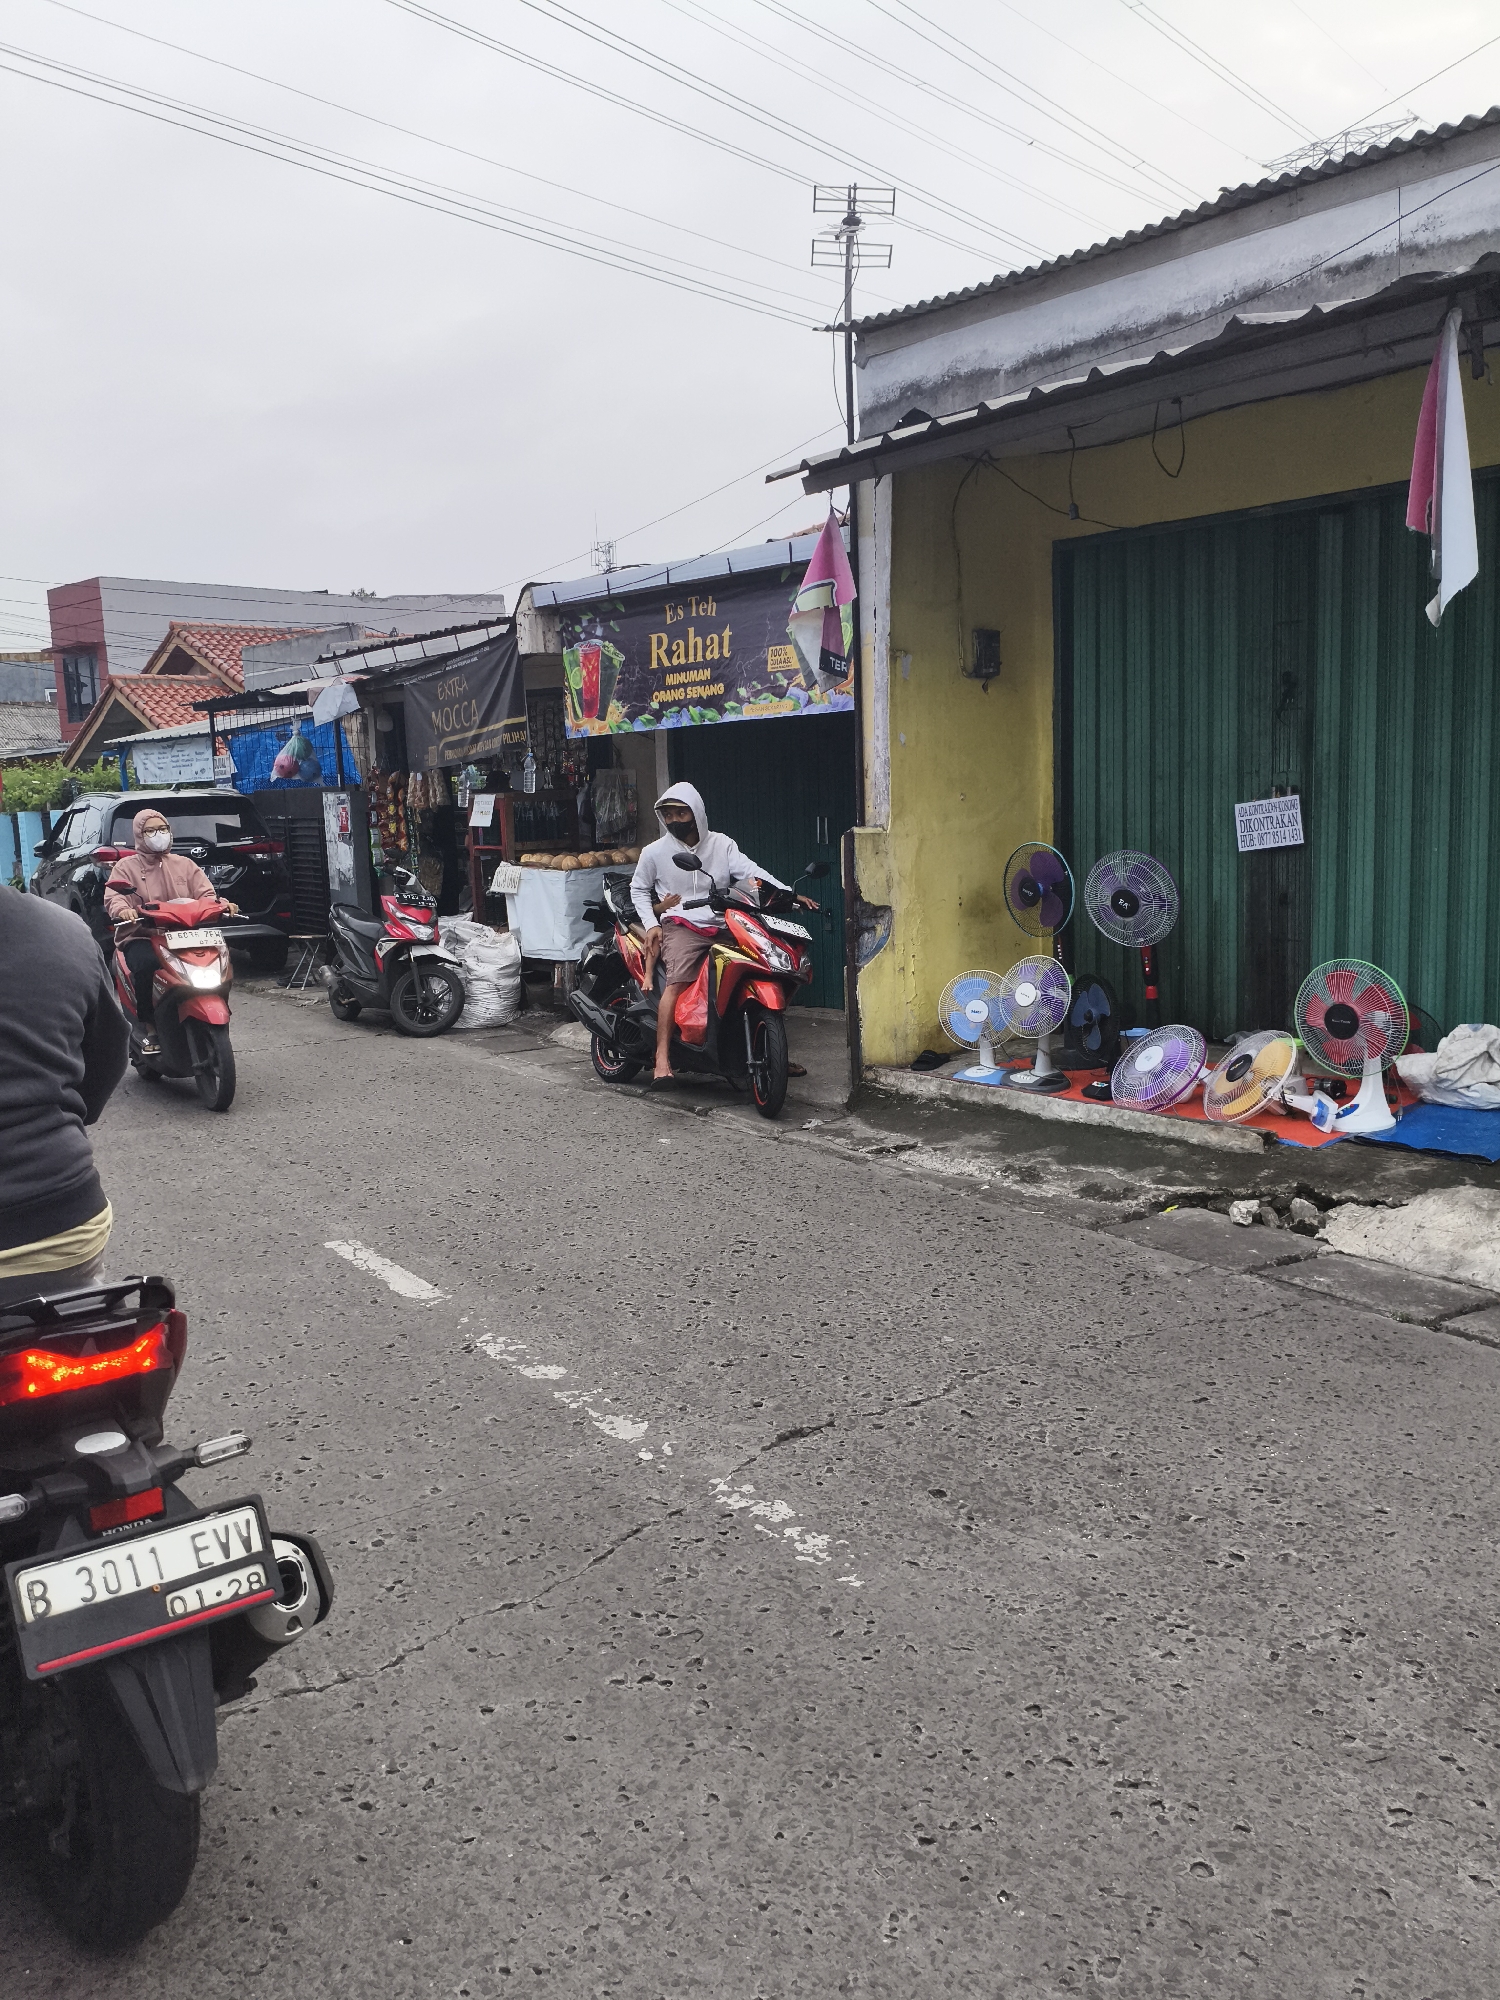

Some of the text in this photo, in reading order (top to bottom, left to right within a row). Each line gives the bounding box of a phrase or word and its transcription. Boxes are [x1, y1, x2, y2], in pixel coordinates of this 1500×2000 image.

[665, 595, 717, 625] Es Teh
[648, 623, 733, 669] Rahat
[770, 646, 788, 658] 100%
[437, 673, 469, 701] EXTRA
[665, 667, 711, 686] MINUMAN
[652, 682, 725, 703] ORANG SENANG
[431, 699, 479, 735] MOCCA
[1239, 812, 1299, 834] DIKONTRAKAN
[1240, 834, 1257, 849] HUB:
[1272, 829, 1287, 844] 8514
[101, 1518, 153, 1537] HONDA
[26, 1517, 253, 1619] B 3011 EVV
